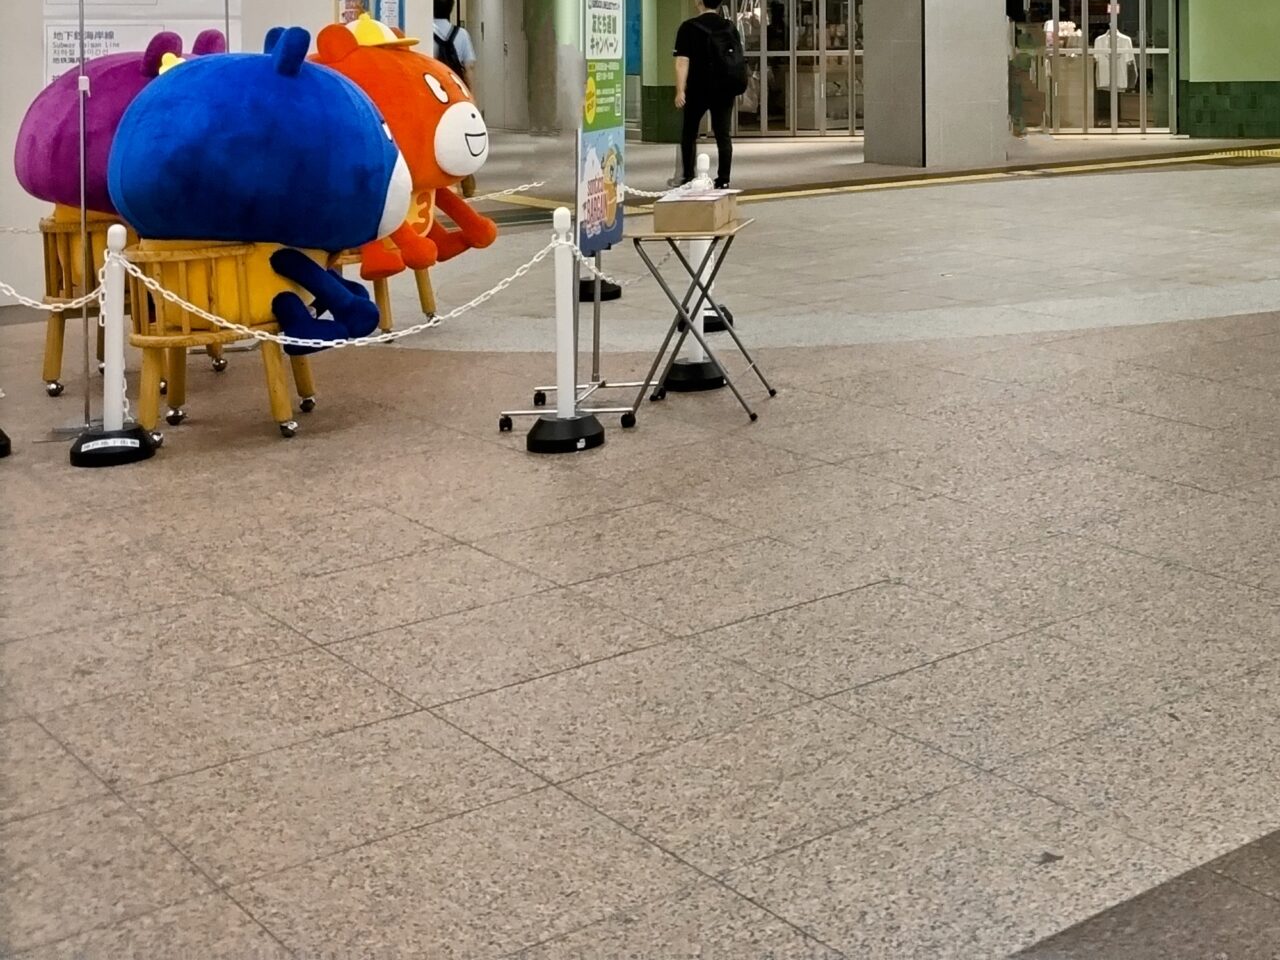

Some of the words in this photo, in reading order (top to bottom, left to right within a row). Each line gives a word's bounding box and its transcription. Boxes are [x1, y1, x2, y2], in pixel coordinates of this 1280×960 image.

[589, 35, 618, 56] キャンペーン
